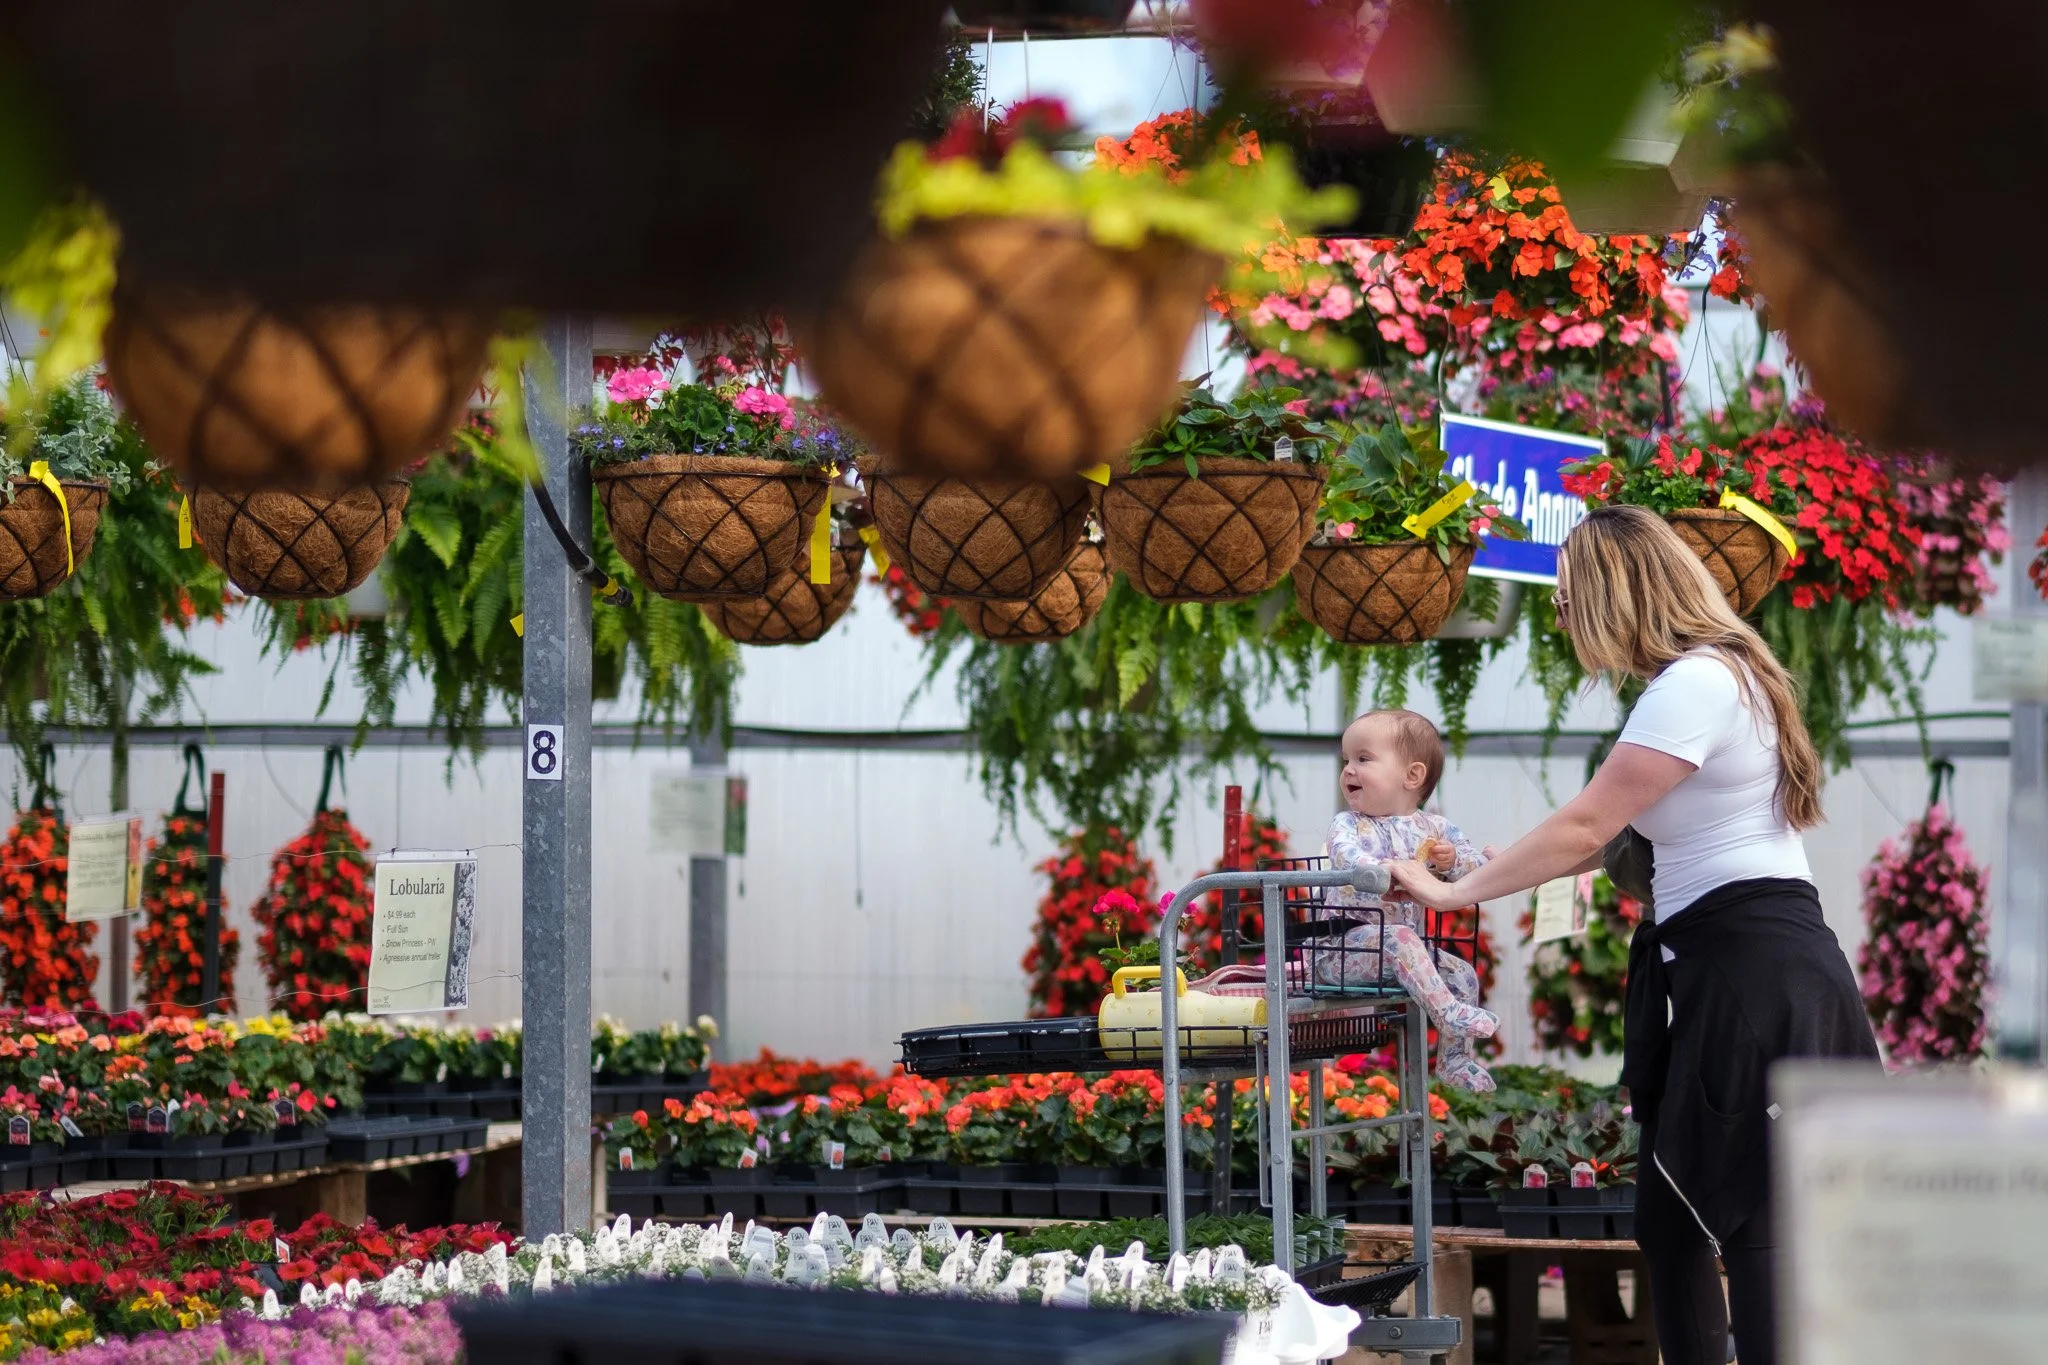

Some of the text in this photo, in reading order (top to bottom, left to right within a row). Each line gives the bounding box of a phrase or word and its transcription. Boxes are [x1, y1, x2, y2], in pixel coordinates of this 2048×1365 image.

[531, 730, 556, 774] 8
[389, 877, 445, 896] Lobularia
[387, 910, 416, 919] $4.99 each
[387, 925, 409, 934] Full Sun
[386, 939, 401, 948] Snow
[402, 938, 424, 948] Princess
[411, 954, 427, 962] annual
